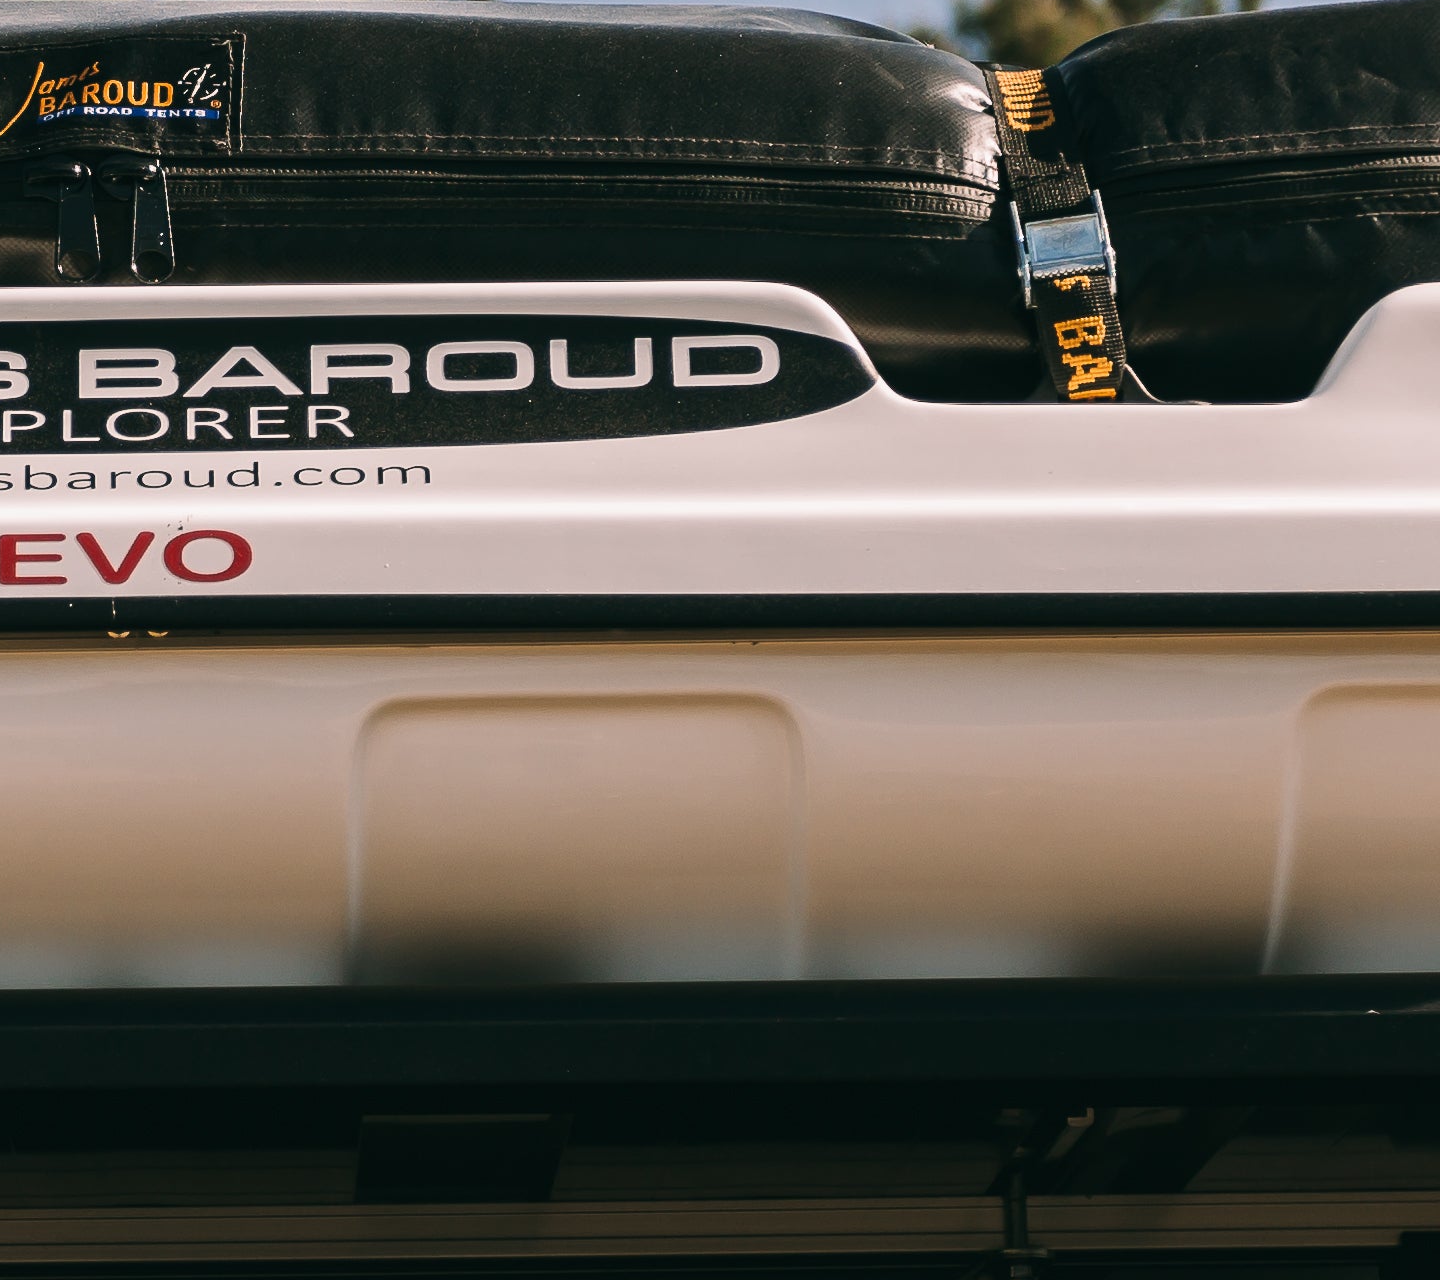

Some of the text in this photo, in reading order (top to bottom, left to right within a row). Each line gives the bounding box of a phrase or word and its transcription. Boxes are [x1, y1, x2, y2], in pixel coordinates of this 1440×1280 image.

[38, 78, 174, 117] BAROUD
[83, 106, 133, 117] ROAD
[145, 107, 207, 119] TENTS
[78, 334, 781, 399] BAROUD
